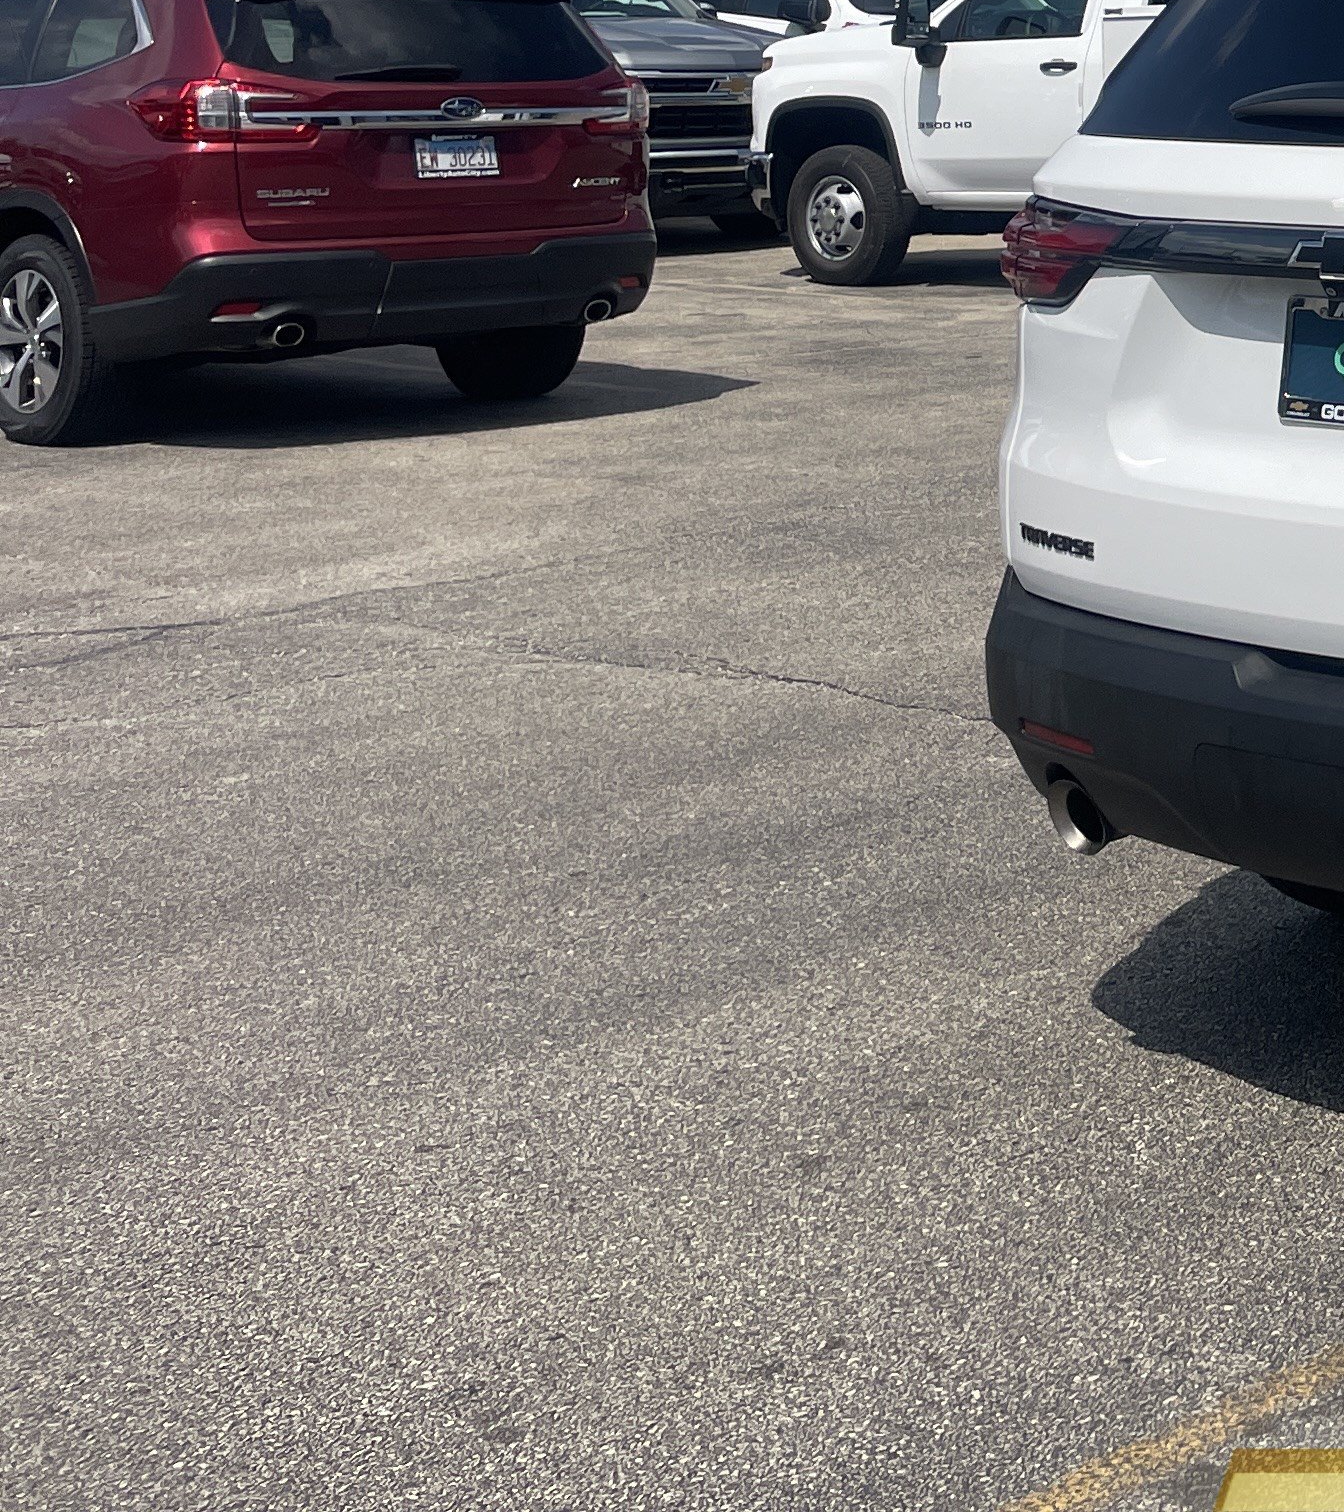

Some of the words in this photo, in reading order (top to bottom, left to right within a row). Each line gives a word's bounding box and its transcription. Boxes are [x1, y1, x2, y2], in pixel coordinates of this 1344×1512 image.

[954, 121, 972, 129] HD
[448, 146, 495, 168] 30231
[256, 188, 330, 199] SUBARU
[1019, 521, 1095, 561] TRAVERSE
